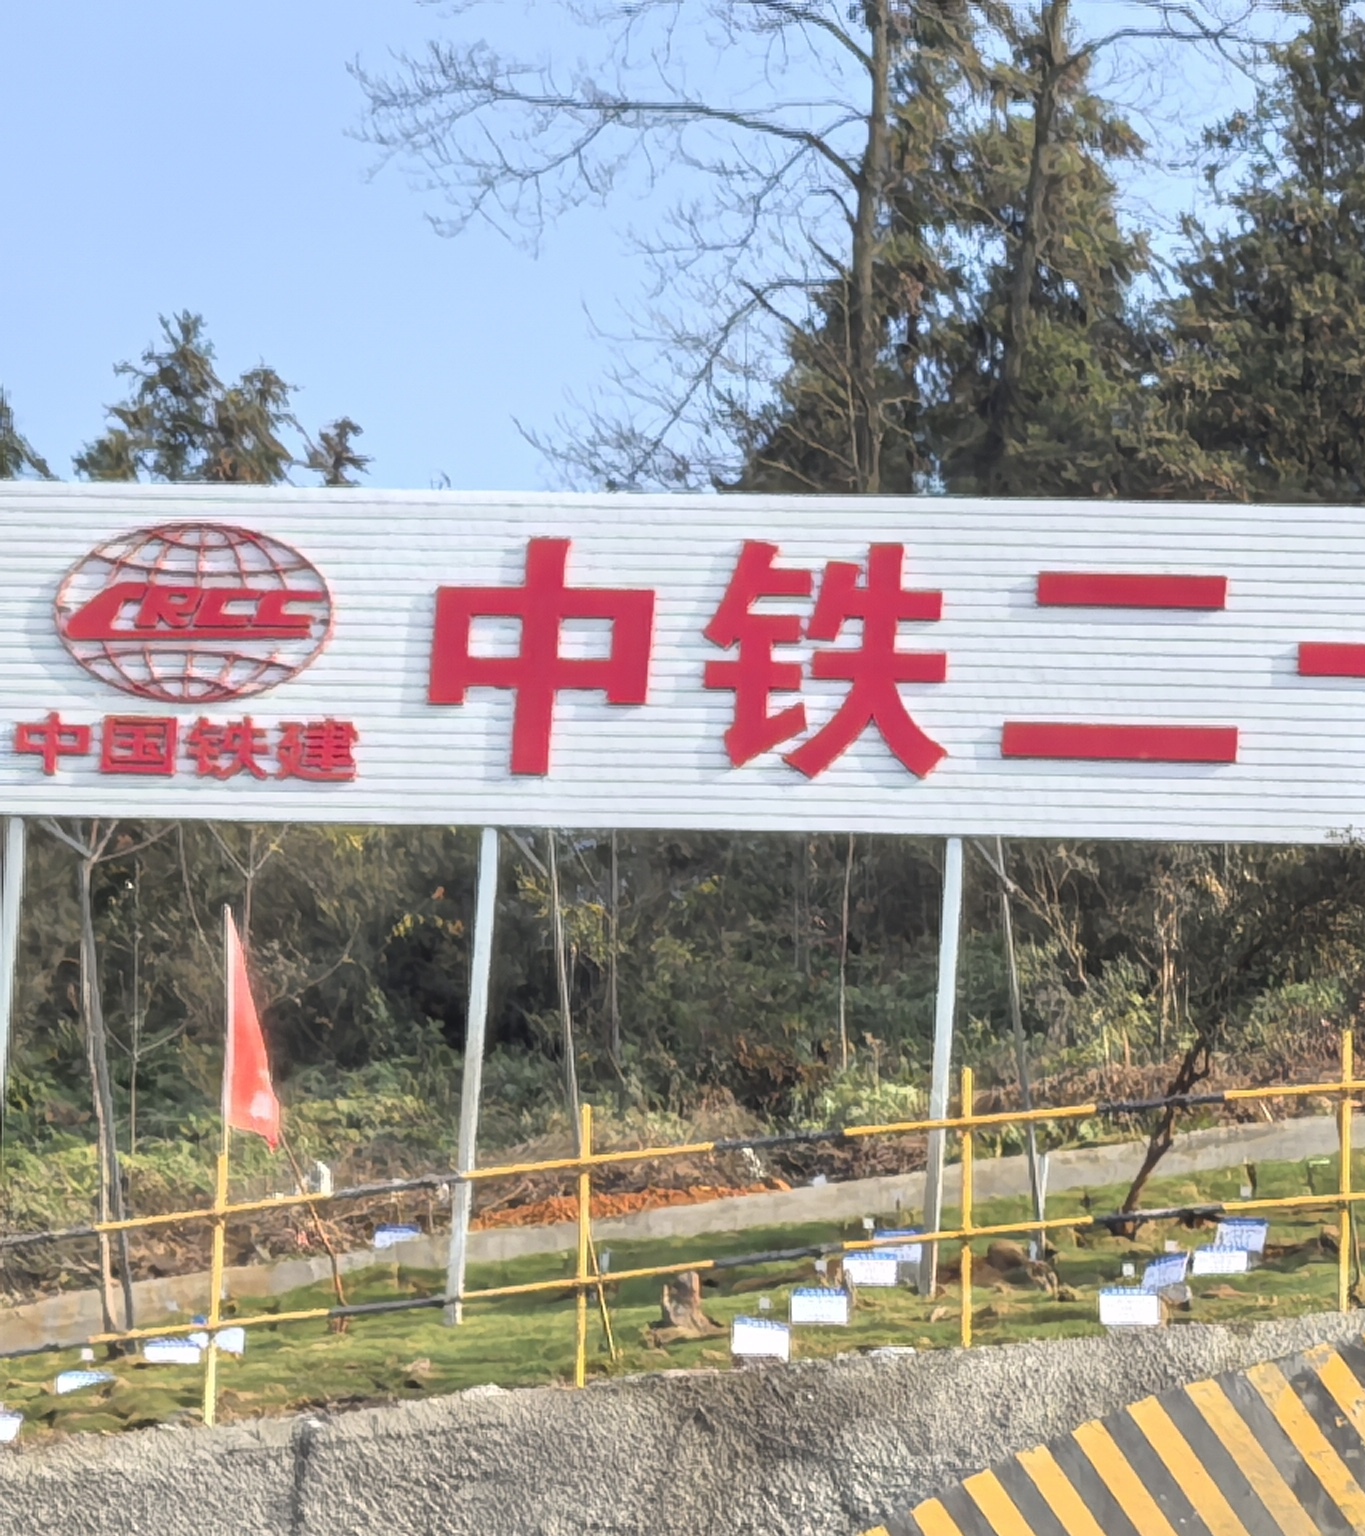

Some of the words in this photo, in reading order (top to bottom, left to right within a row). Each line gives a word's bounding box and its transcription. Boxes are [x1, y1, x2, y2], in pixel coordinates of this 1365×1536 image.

[66, 582, 326, 641] CRCC
[14, 711, 358, 782] 中国铁建
